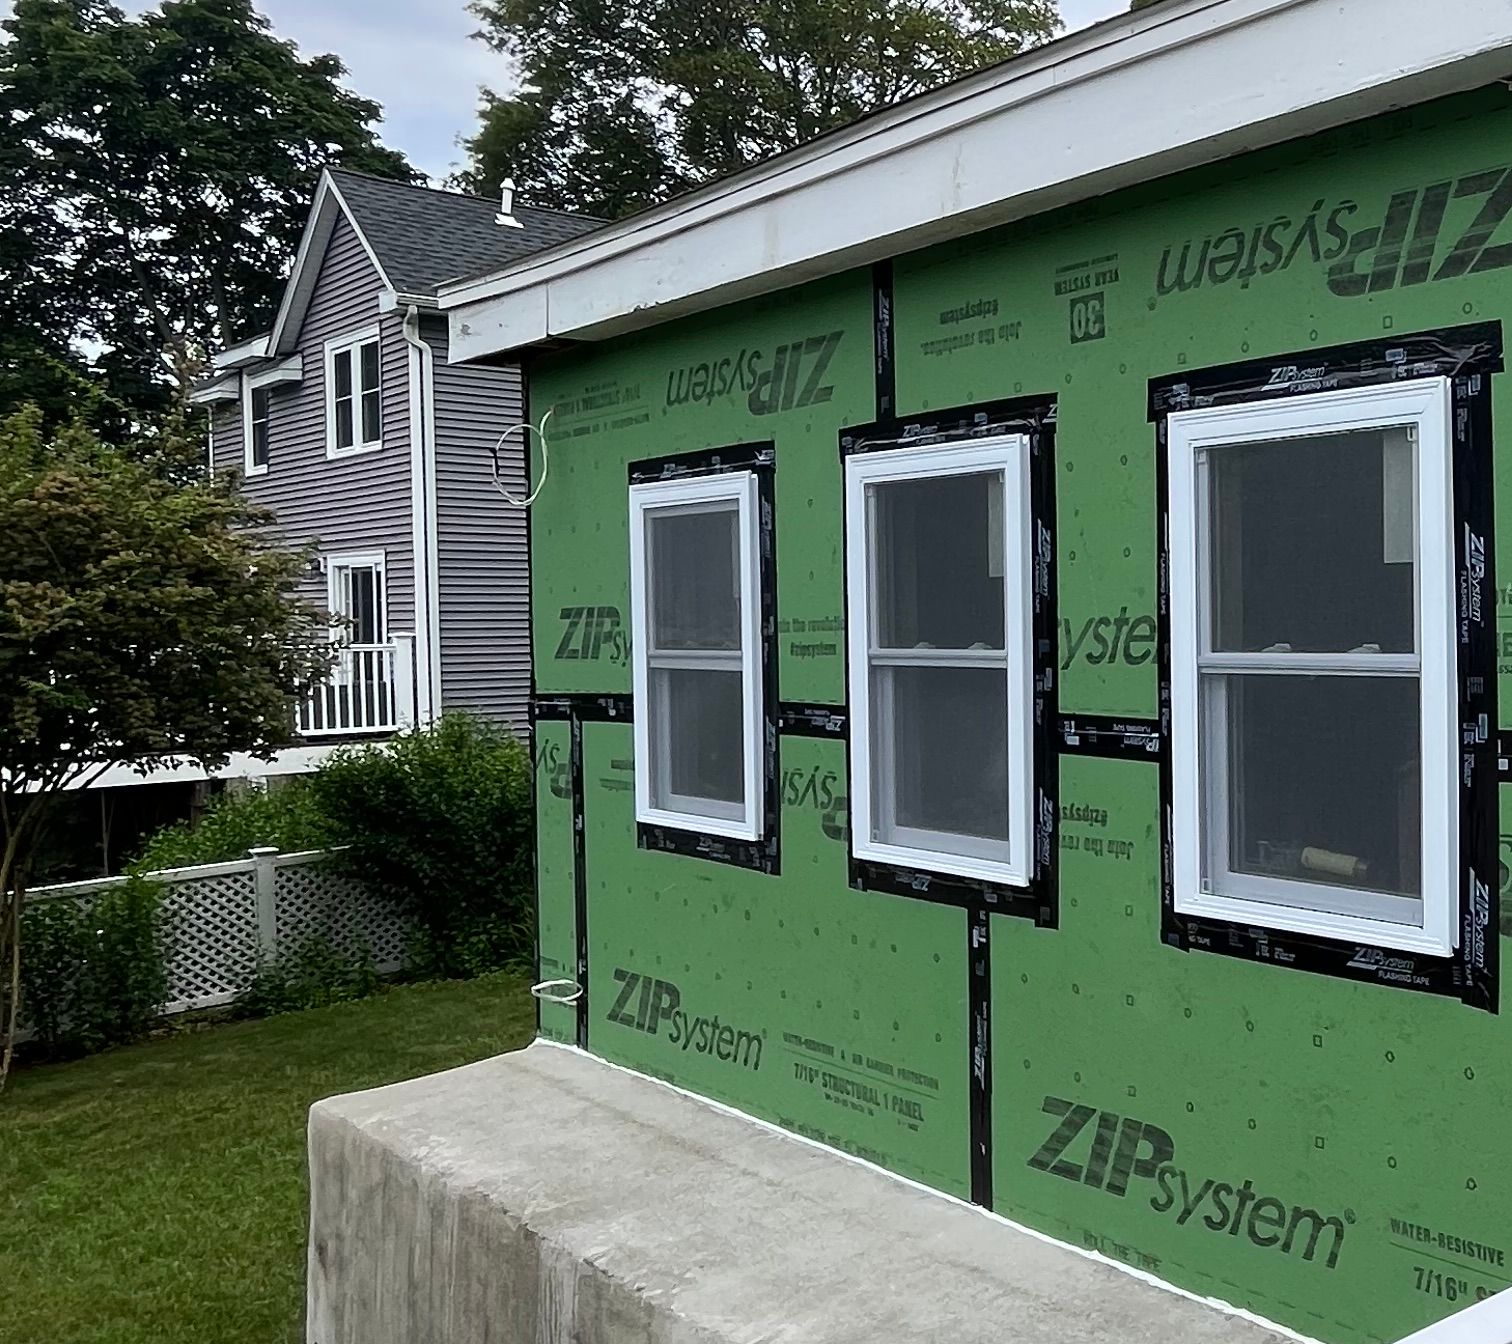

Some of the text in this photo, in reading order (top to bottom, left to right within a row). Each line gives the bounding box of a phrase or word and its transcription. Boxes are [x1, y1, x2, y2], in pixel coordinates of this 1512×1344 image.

[1072, 298, 1103, 342] 30
[1061, 803, 1108, 828] #zipsys
[606, 967, 763, 1072] ZIPsystem
[1026, 1095, 1345, 1270] ZIPsystem
